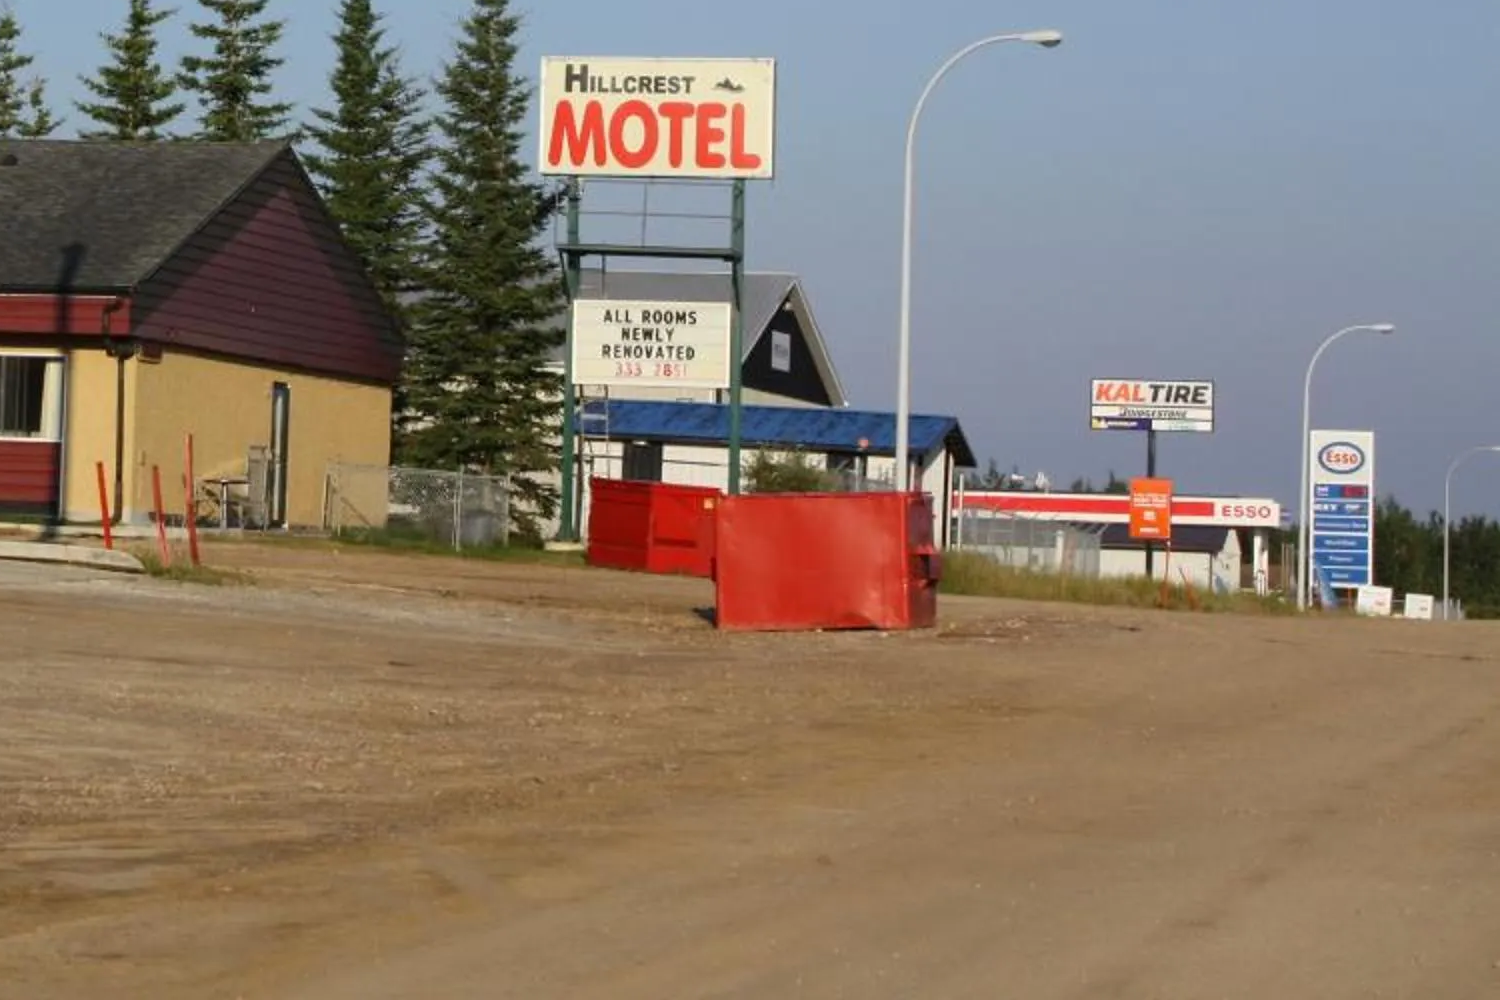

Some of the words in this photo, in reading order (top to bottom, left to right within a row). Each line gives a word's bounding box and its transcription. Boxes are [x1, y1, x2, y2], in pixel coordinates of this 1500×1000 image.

[564, 63, 696, 95] HILLCREST
[547, 99, 762, 169] MOTEL
[603, 309, 633, 324] ALL
[641, 309, 698, 325] ROOMS
[621, 327, 675, 343] NEWLY
[601, 343, 696, 361] RENOVATED
[1221, 504, 1272, 519] ESSO
